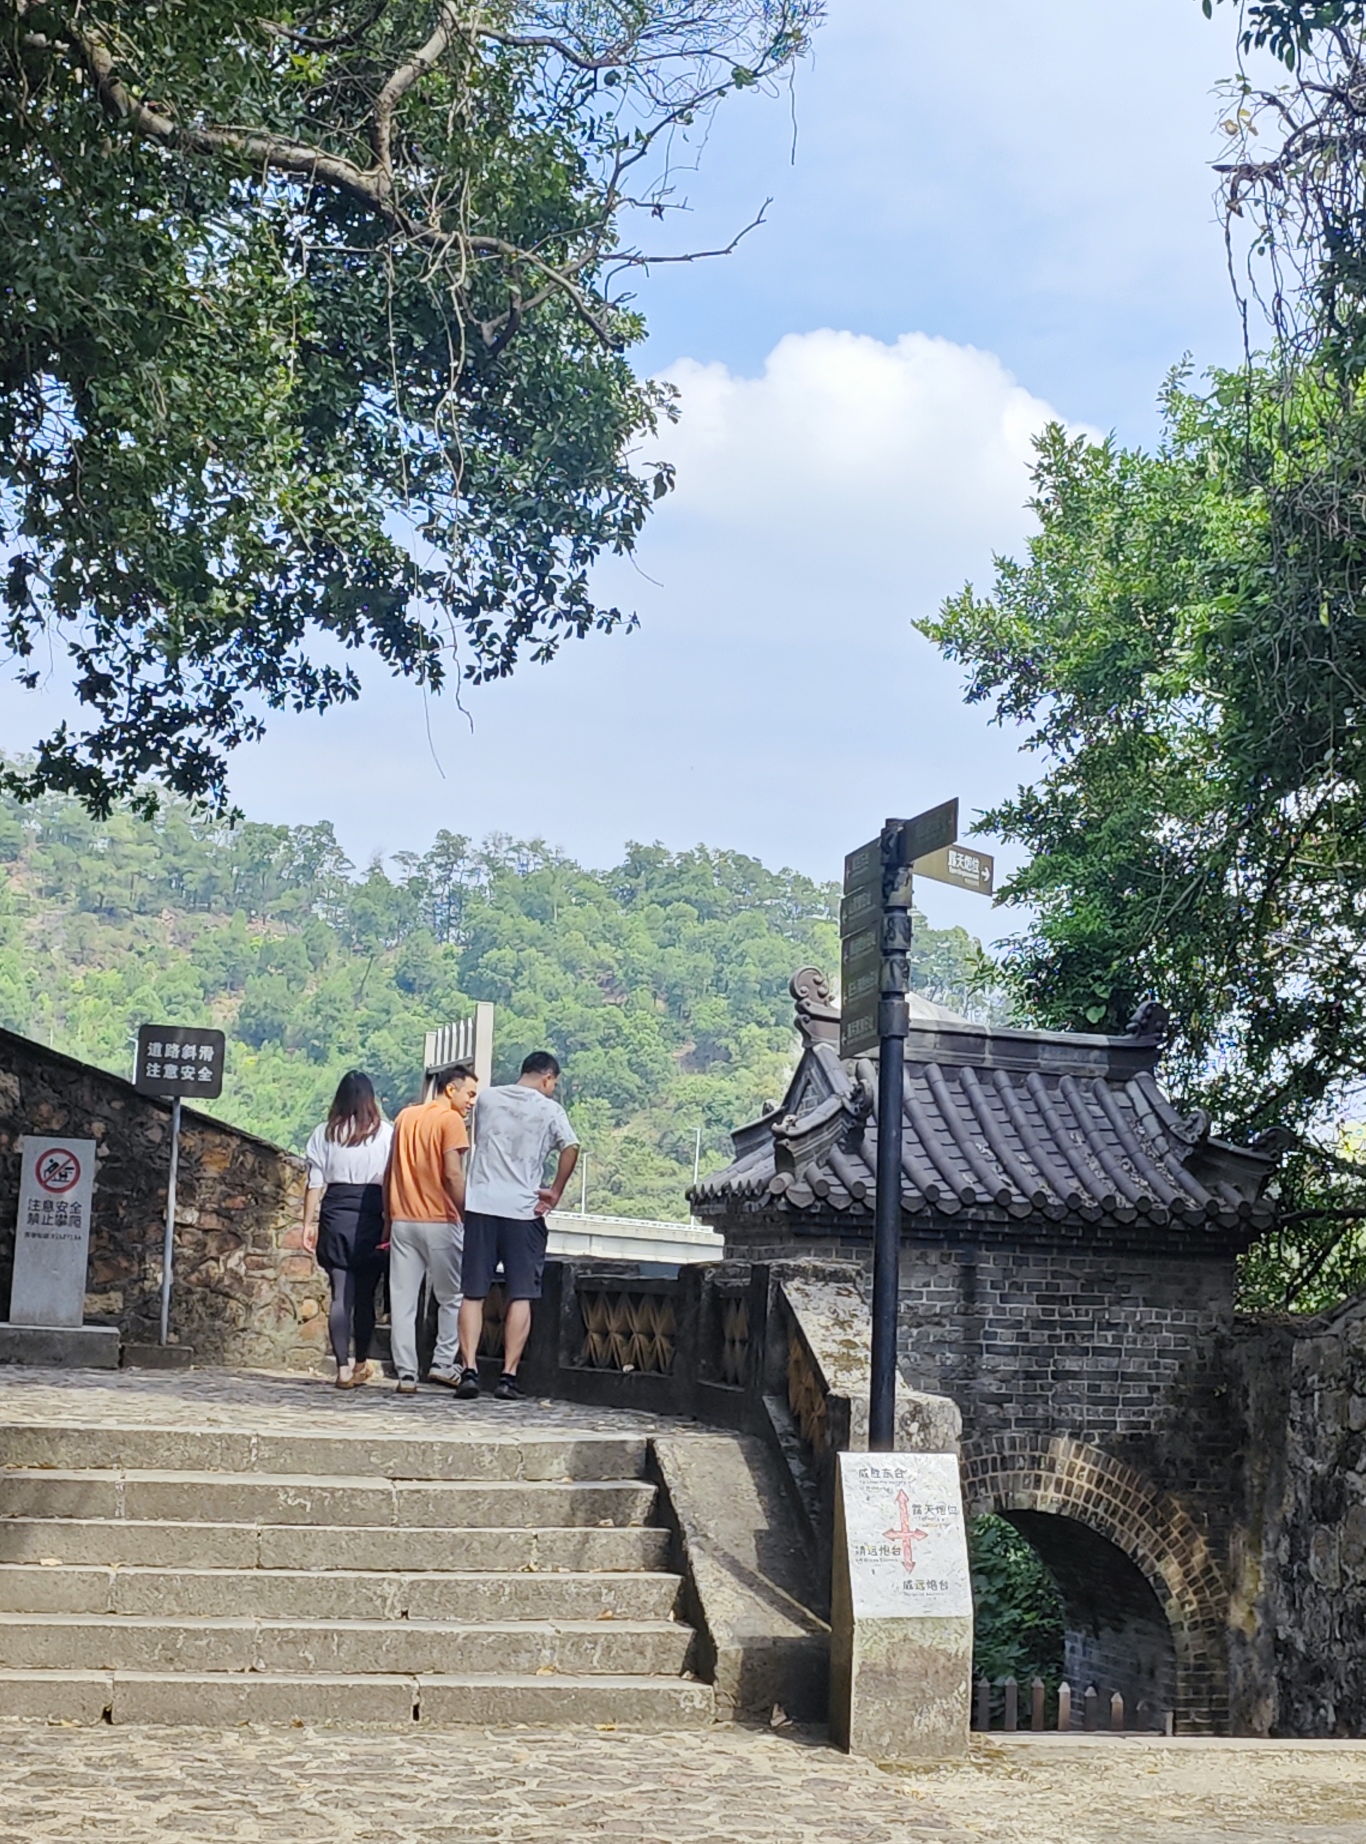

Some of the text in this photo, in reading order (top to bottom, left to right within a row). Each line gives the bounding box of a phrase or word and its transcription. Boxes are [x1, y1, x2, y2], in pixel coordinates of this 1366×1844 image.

[147, 1041, 214, 1062] 道路斜滑
[146, 1062, 213, 1082] 注意安全
[27, 1199, 82, 1214] 注意安全
